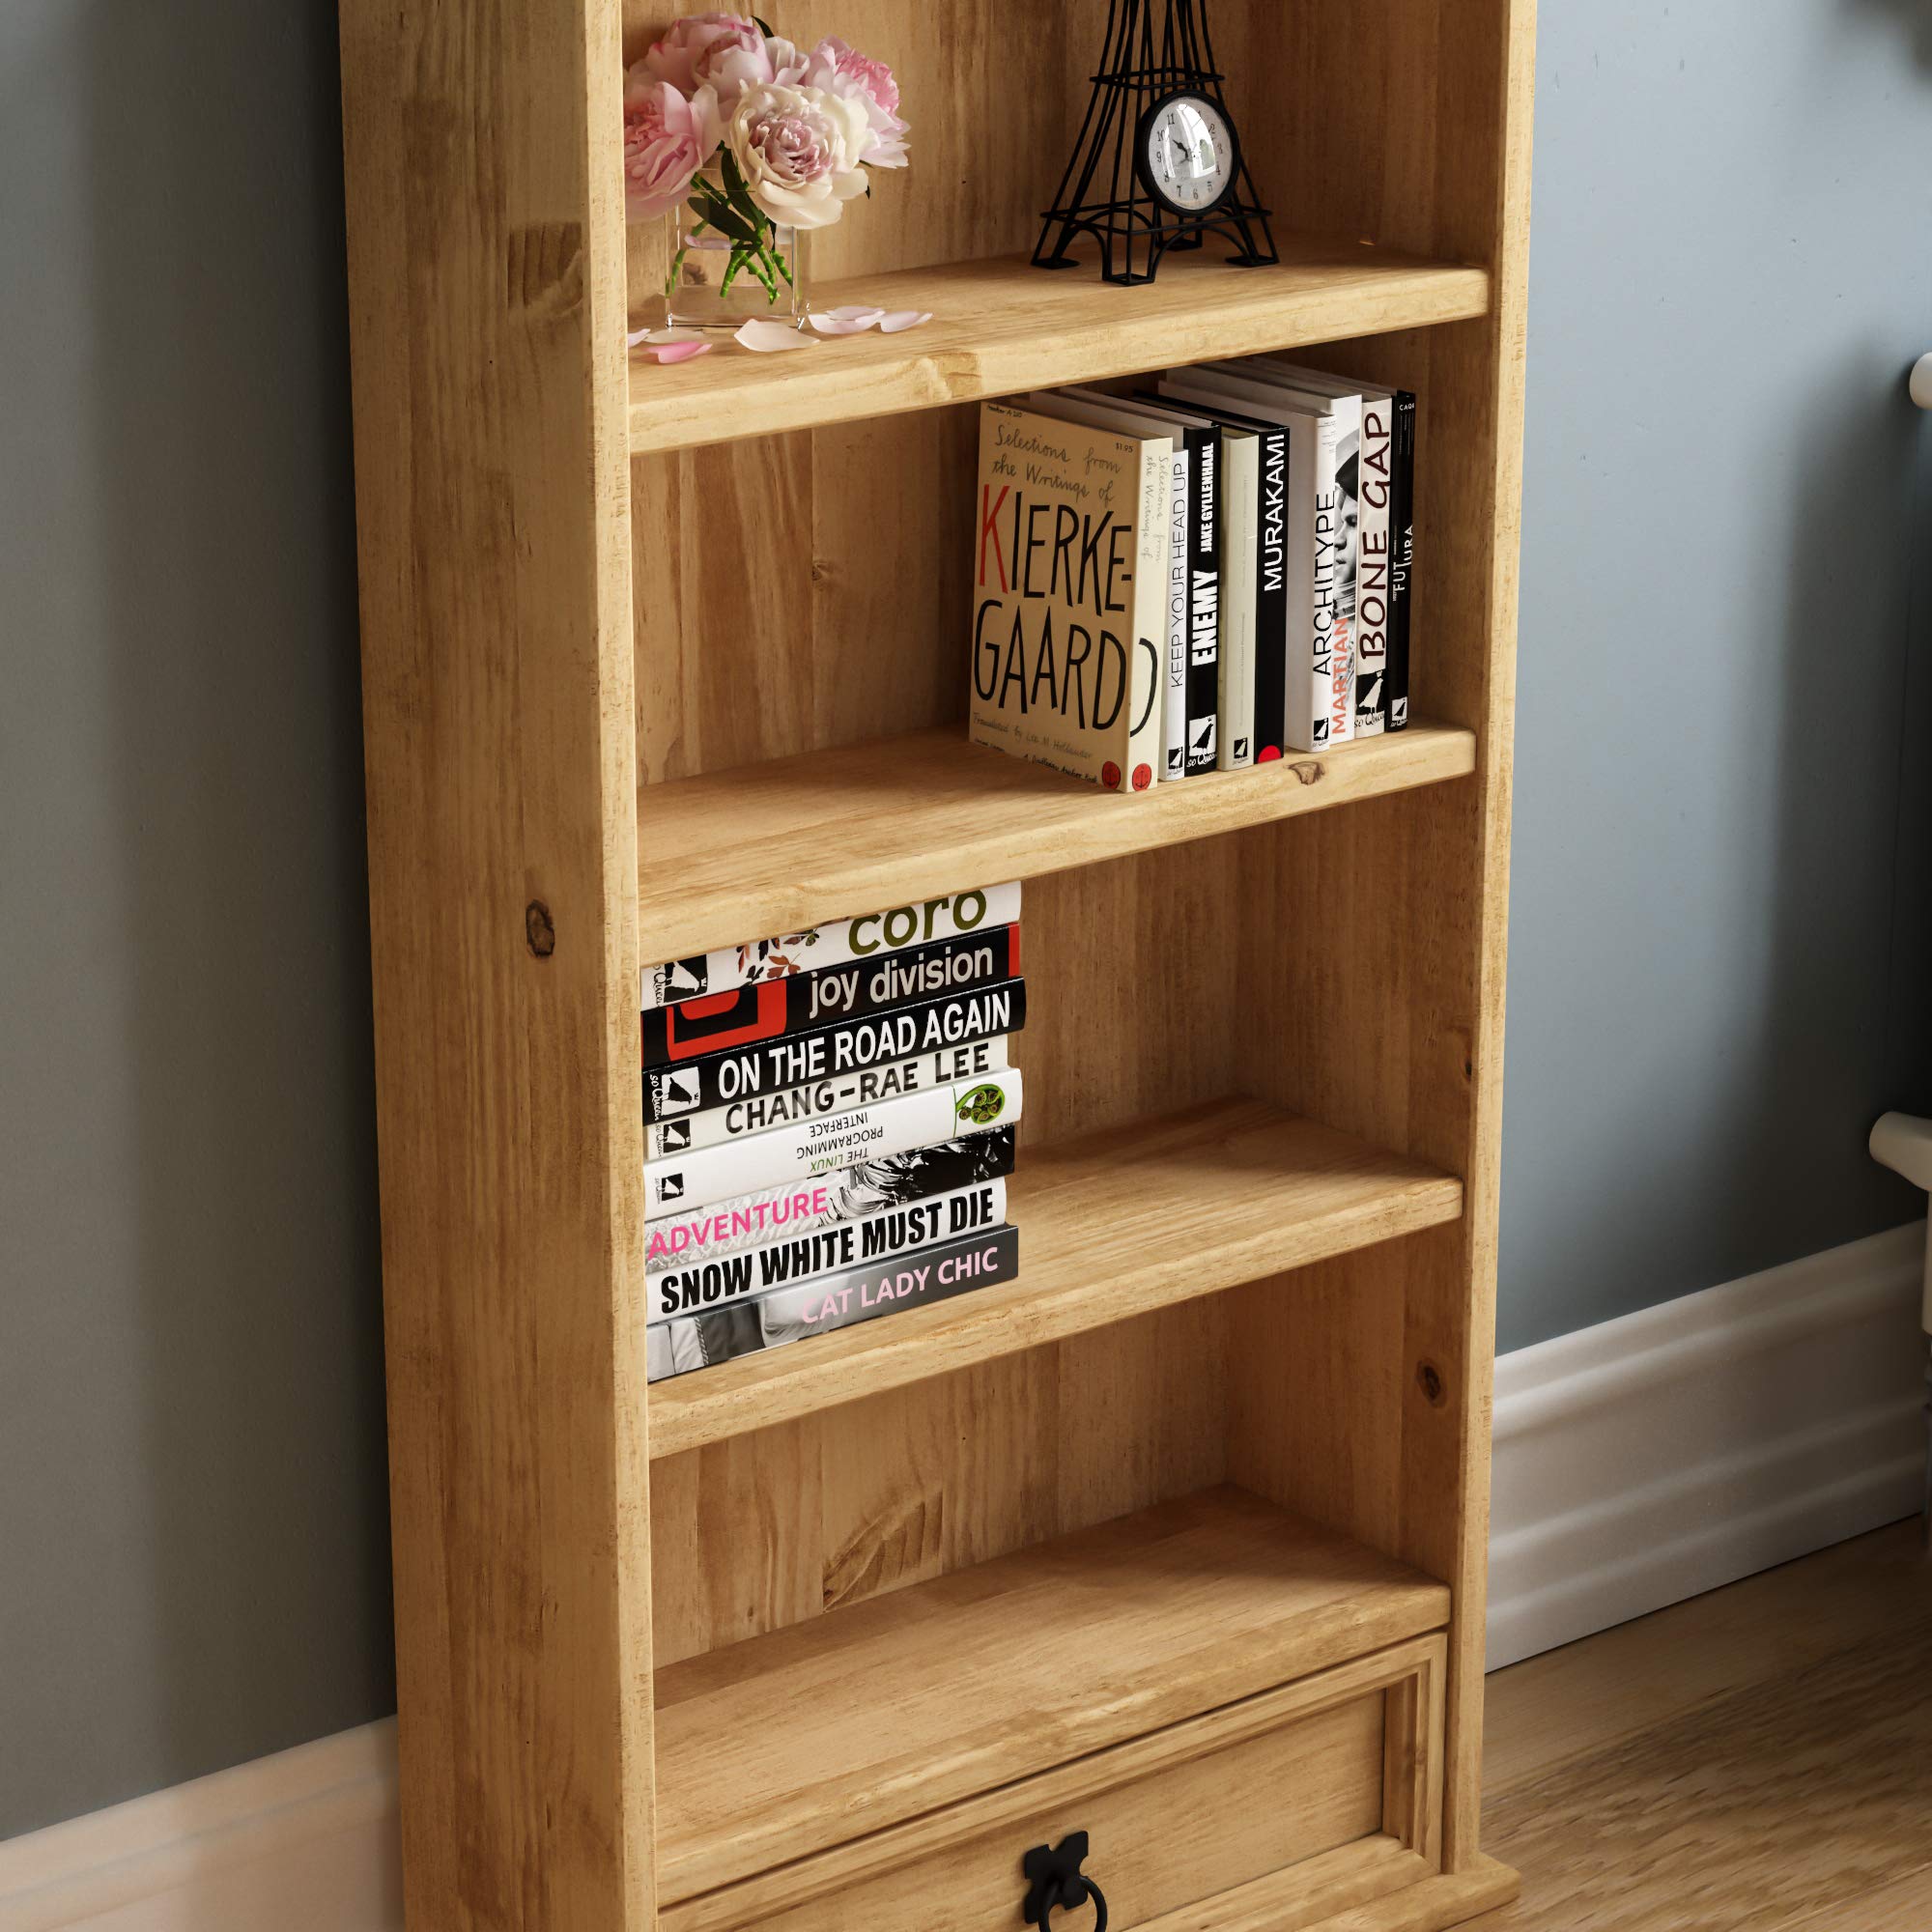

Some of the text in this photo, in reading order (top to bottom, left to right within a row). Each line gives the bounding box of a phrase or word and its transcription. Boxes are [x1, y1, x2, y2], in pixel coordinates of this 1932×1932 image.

[991, 453, 1115, 508] the Writings of
[995, 424, 1122, 475] Selections from
[1200, 522, 1213, 553] JAKE
[1264, 434, 1285, 592] MURAKAMI
[1358, 412, 1391, 661] BONE GAP
[1171, 463, 1186, 688] KEEP YOUR HEAD UP
[1313, 490, 1335, 676] ARCHITYPE
[1191, 570, 1218, 667] ENEMY
[974, 599, 1127, 731] GAARD
[1331, 616, 1350, 734] MARTIAN
[809, 947, 993, 1019] joy division
[649, 1073, 660, 1088] so
[718, 990, 1011, 1098] ON THE ROAD AGAIN
[724, 1042, 989, 1133] CHANG-RAE LEE
[809, 1111, 868, 1138] INTERFACE
[796, 1125, 884, 1160] PROGRAMMING
[810, 1148, 869, 1173] THE LINUX
[647, 1187, 828, 1261] ADVENTURE
[661, 1187, 994, 1315] SNOW WHITE MUST DIE
[802, 1247, 999, 1324] CAT LADY CHIC
